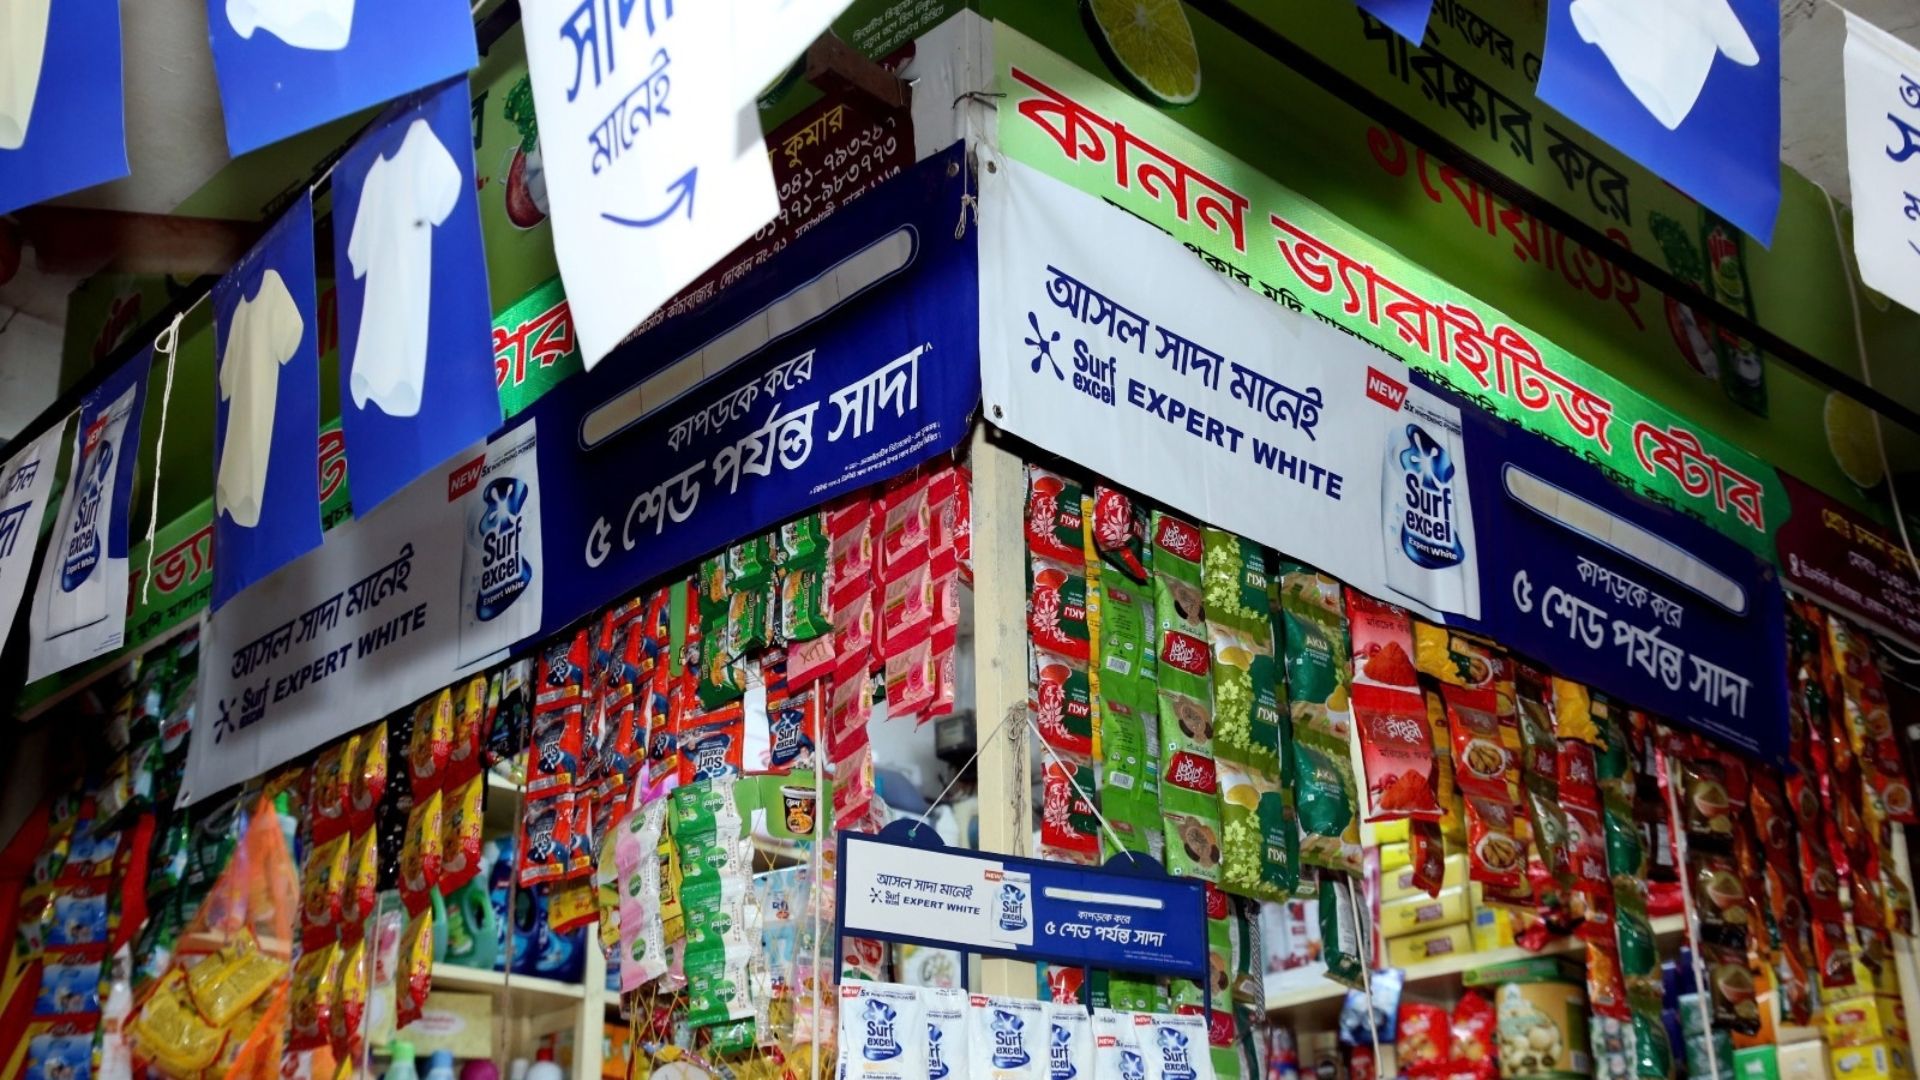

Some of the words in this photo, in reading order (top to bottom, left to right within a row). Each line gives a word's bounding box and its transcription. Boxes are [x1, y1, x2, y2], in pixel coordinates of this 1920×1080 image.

[587, 47, 672, 176] মানেই
[782, 104, 845, 169] কুমার
[1544, 123, 1631, 227] করে
[1011, 66, 1250, 253] কানন
[1270, 215, 1613, 454] ভ্যারাইটিজ
[1046, 264, 1150, 354] আসল
[1155, 325, 1224, 390] সাদা
[1230, 362, 1324, 441] মানেই
[1073, 339, 1117, 386] Surf
[667, 378, 761, 452] কাপড়কে
[764, 348, 816, 399] করে
[1073, 372, 1116, 406] excel
[1368, 376, 1402, 405] NEW
[1128, 378, 1244, 453] EXPERT
[1253, 438, 1343, 500] WHITE
[585, 516, 613, 568] ৫
[622, 461, 706, 551] শেড
[713, 401, 821, 495] পর্যন্ত
[827, 345, 924, 442] সাদা
[450, 464, 482, 493] NEW
[1406, 473, 1453, 520] Surf
[1059, 513, 1081, 528] AKIJ
[1406, 509, 1452, 543] excel
[68, 523, 95, 557] excel
[482, 516, 522, 568] Surf
[1408, 536, 1430, 554] Expert
[1430, 545, 1458, 561] White
[481, 551, 520, 590] excel
[504, 580, 525, 595] White
[1577, 555, 1649, 609] কাপড়কে
[1650, 591, 1683, 628] করে
[232, 619, 296, 679] আসল
[296, 591, 343, 645] সাদা
[345, 542, 414, 619] মানেই
[1063, 606, 1085, 620] AKIJ
[273, 643, 352, 704] EXPERT
[357, 603, 427, 659] WHITE
[1513, 569, 1533, 613] ৫
[1542, 586, 1608, 650] শেড
[1612, 620, 1685, 691] পর্যন্ত
[1689, 654, 1751, 718] সাদা
[241, 678, 270, 714] Surf
[1068, 702, 1088, 716] AKIJ
[1257, 706, 1279, 722] AKIJ
[778, 725, 800, 741] Surf
[698, 756, 723, 771] Surf
[703, 797, 724, 807] Dettol
[707, 852, 728, 864] Dettol
[877, 873, 912, 890] আসল
[914, 879, 937, 894] সাদা
[939, 883, 974, 900] মানেই
[985, 872, 1002, 881] NEW
[885, 890, 900, 902] Surf
[903, 896, 944, 910] EXPERT
[946, 903, 980, 915] WHITE
[1002, 901, 1023, 914] Surf
[710, 918, 732, 930] Dettol
[1002, 911, 1022, 921] excel
[1113, 914, 1132, 925] করে
[1045, 920, 1056, 935] ৫
[1059, 922, 1092, 939] শেড
[1095, 925, 1132, 944] পর্যন্ত
[1133, 929, 1165, 947] সাদা
[714, 986, 736, 997] Dettol
[867, 1021, 894, 1038] Surf
[867, 1035, 894, 1047] excel
[996, 1031, 1023, 1046] Surf
[996, 1045, 1022, 1055] excel
[1051, 1045, 1069, 1058] urf
[1163, 1048, 1189, 1062] Surf
[1164, 1062, 1189, 1071] excel
